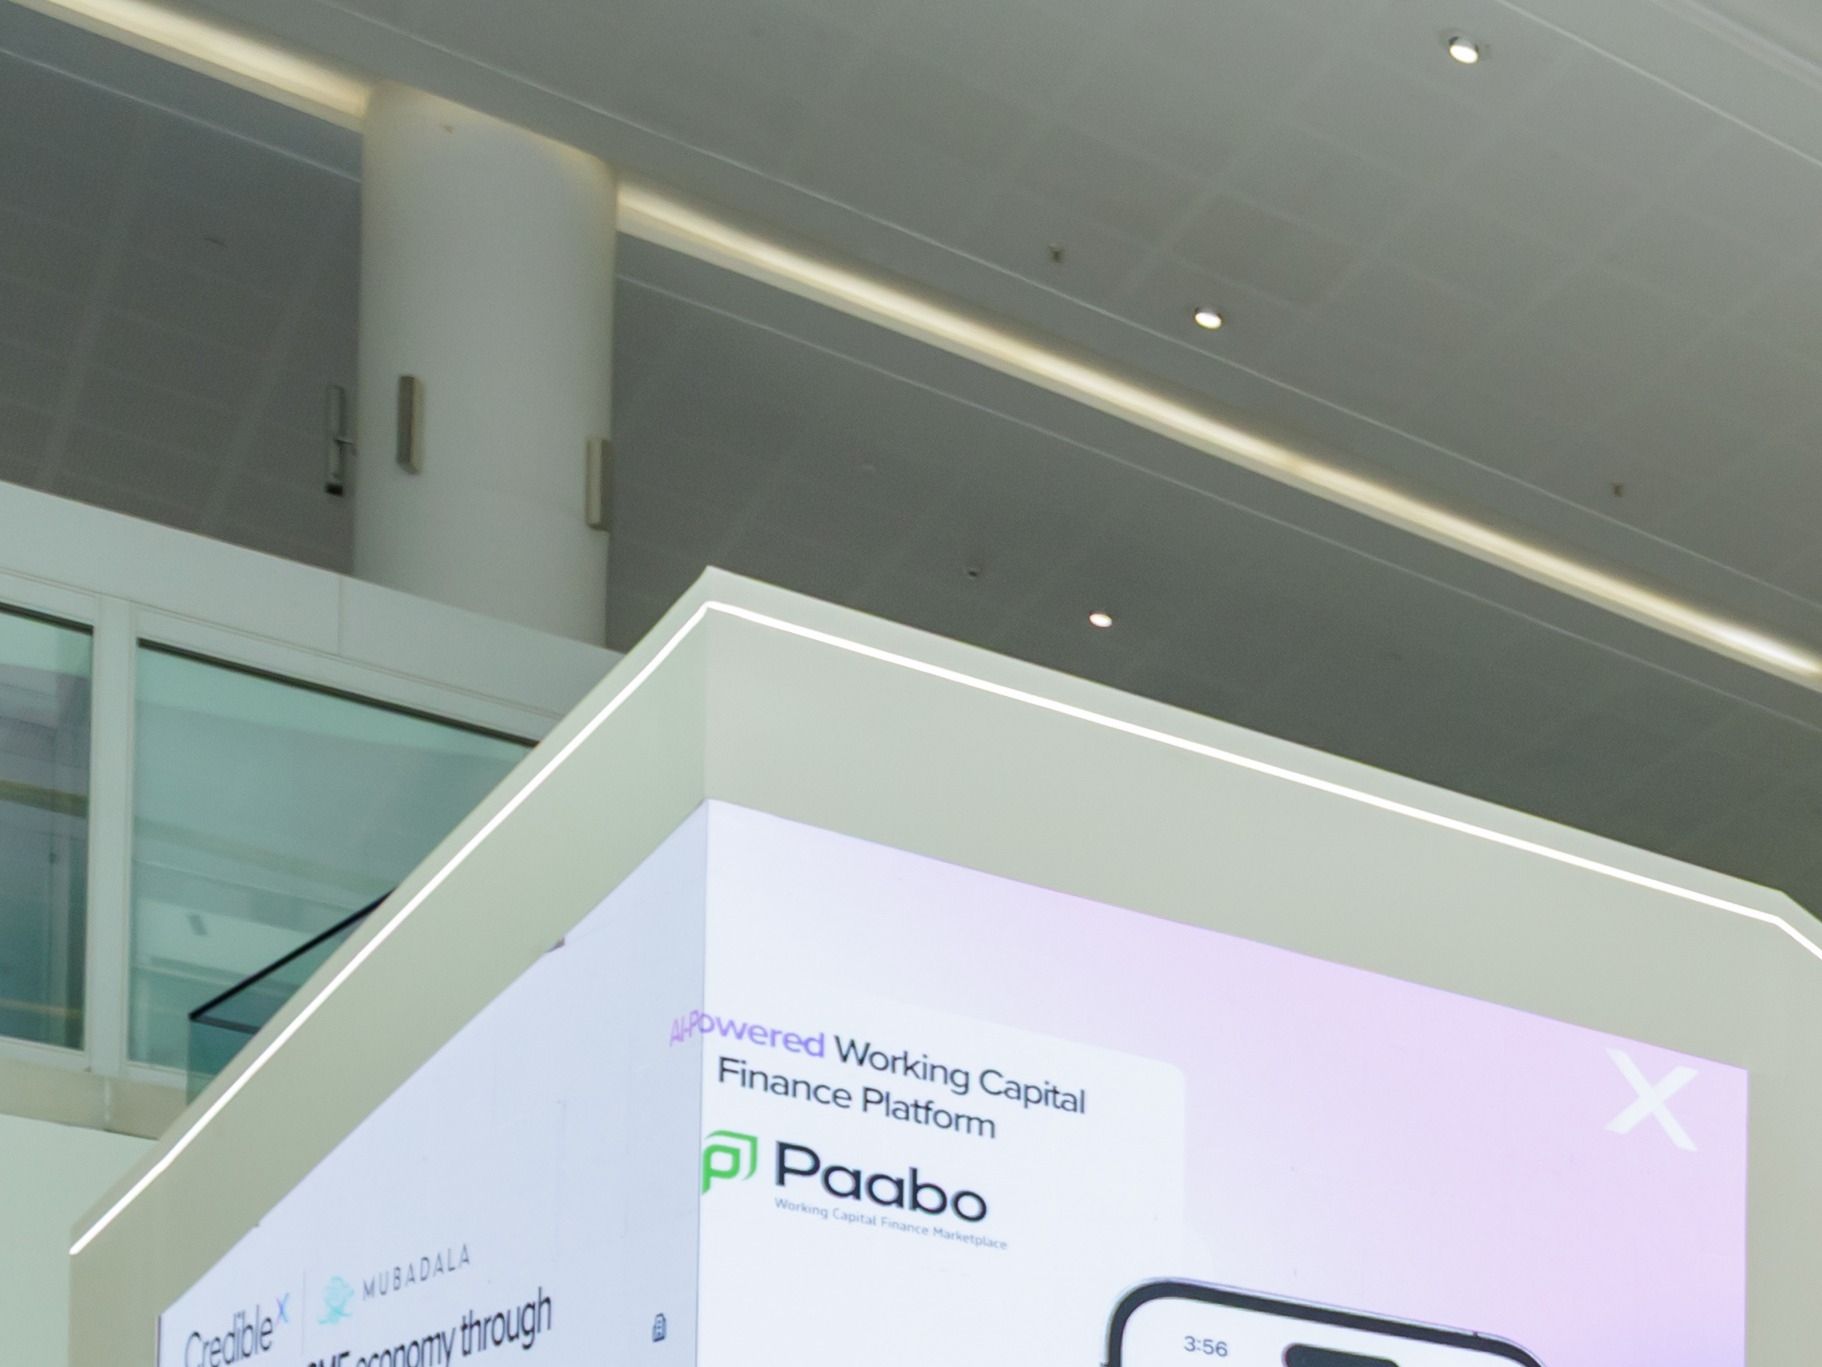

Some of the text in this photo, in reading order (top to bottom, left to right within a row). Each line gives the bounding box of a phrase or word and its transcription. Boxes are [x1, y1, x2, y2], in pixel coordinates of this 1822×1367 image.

[719, 1056, 995, 1138] Finance Platform
[834, 1035, 969, 1096] Working
[979, 1069, 1085, 1114] Capital
[775, 1140, 988, 1223] Paabo
[774, 1197, 1007, 1250] Working Capital Finance Marketplace
[363, 1244, 470, 1300] MUBADALA
[460, 1287, 551, 1357] through
[1183, 1335, 1229, 1358] 3:56
